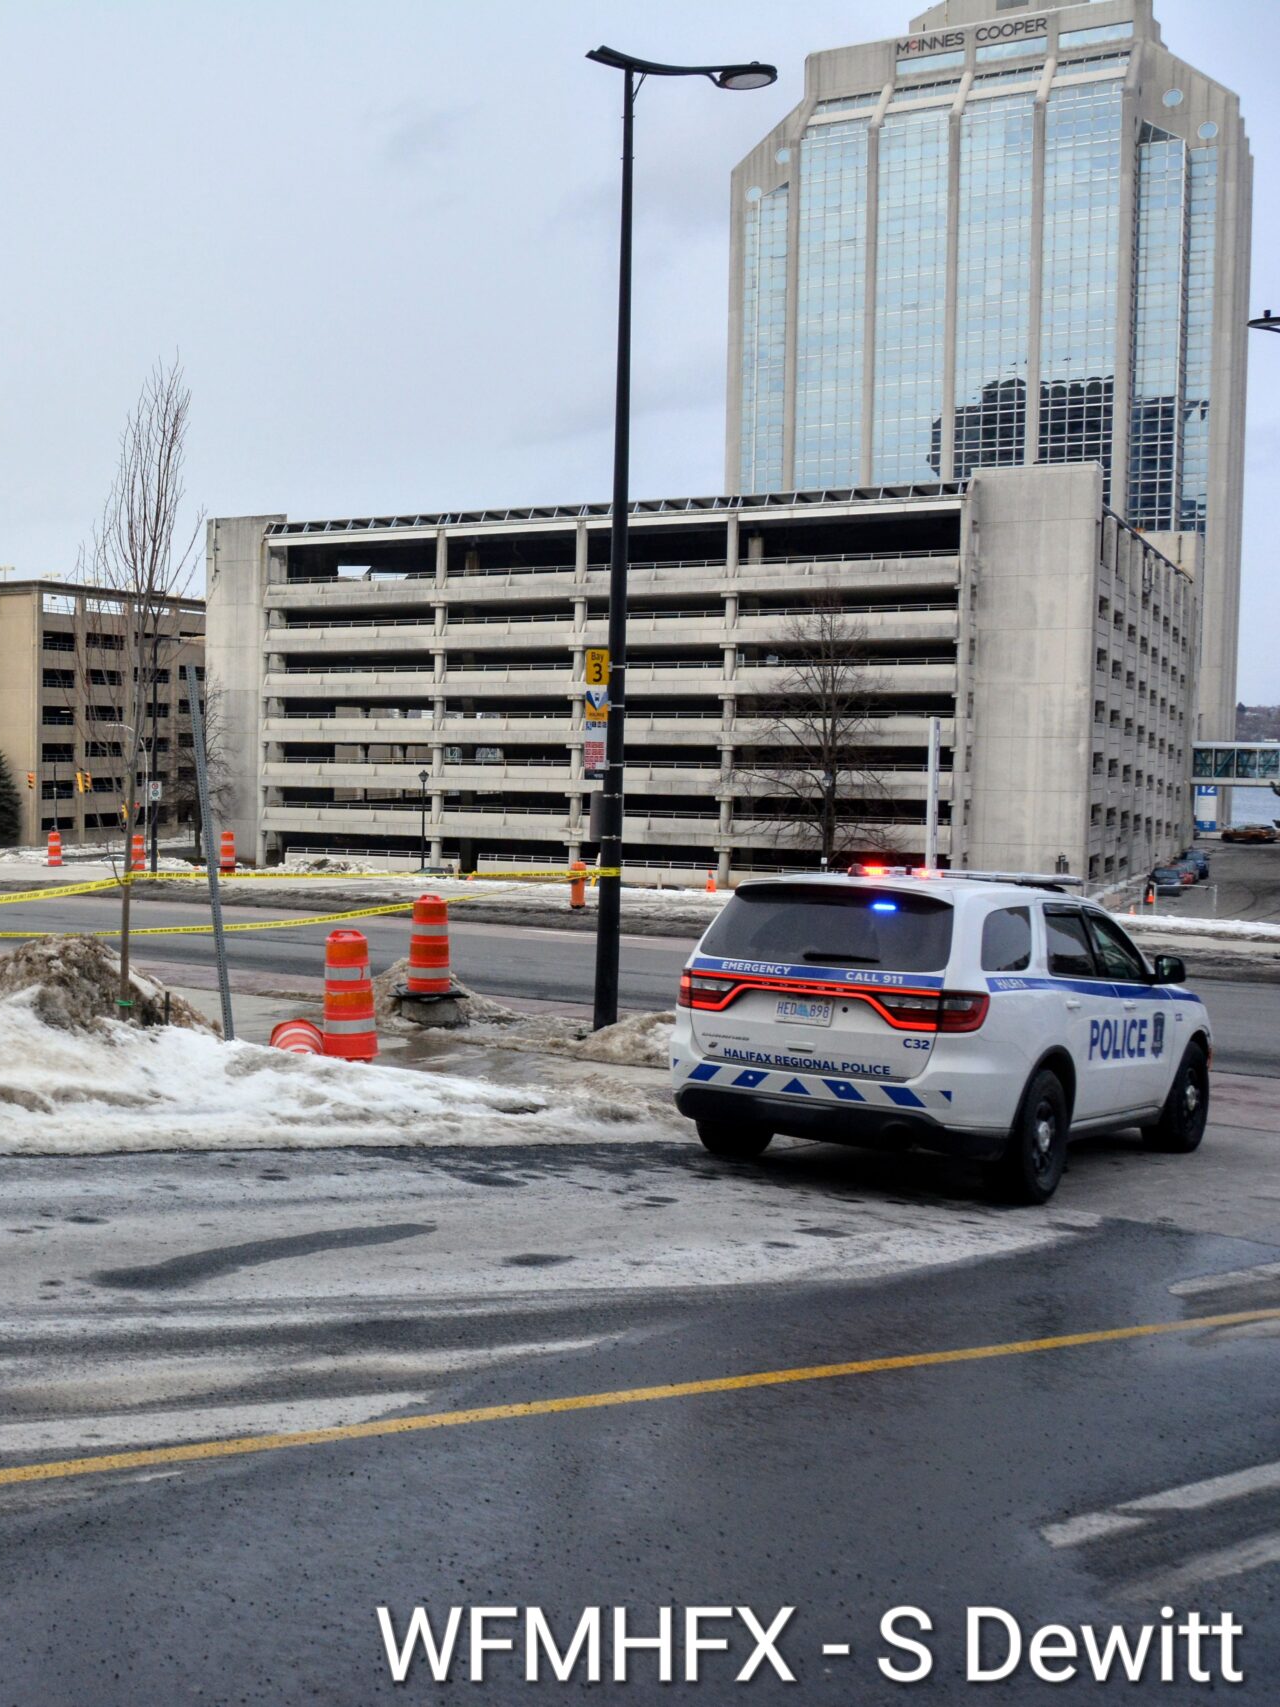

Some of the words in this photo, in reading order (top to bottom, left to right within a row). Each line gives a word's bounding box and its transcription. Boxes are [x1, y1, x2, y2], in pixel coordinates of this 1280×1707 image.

[975, 18, 1047, 42] COOPER
[591, 651, 603, 663] Bay
[592, 662, 602, 683] 3
[721, 961, 792, 976] EMERGENCY
[845, 971, 878, 983] CALL
[883, 974, 904, 985] 911
[776, 1001, 797, 1016] HED
[809, 1004, 830, 1019] 898
[903, 1038, 930, 1050] C32
[1088, 1019, 1148, 1061] POLICE
[724, 1048, 771, 1064] HALIFAX
[775, 1055, 839, 1072] REGIONAL
[842, 1062, 891, 1076] POLICE
